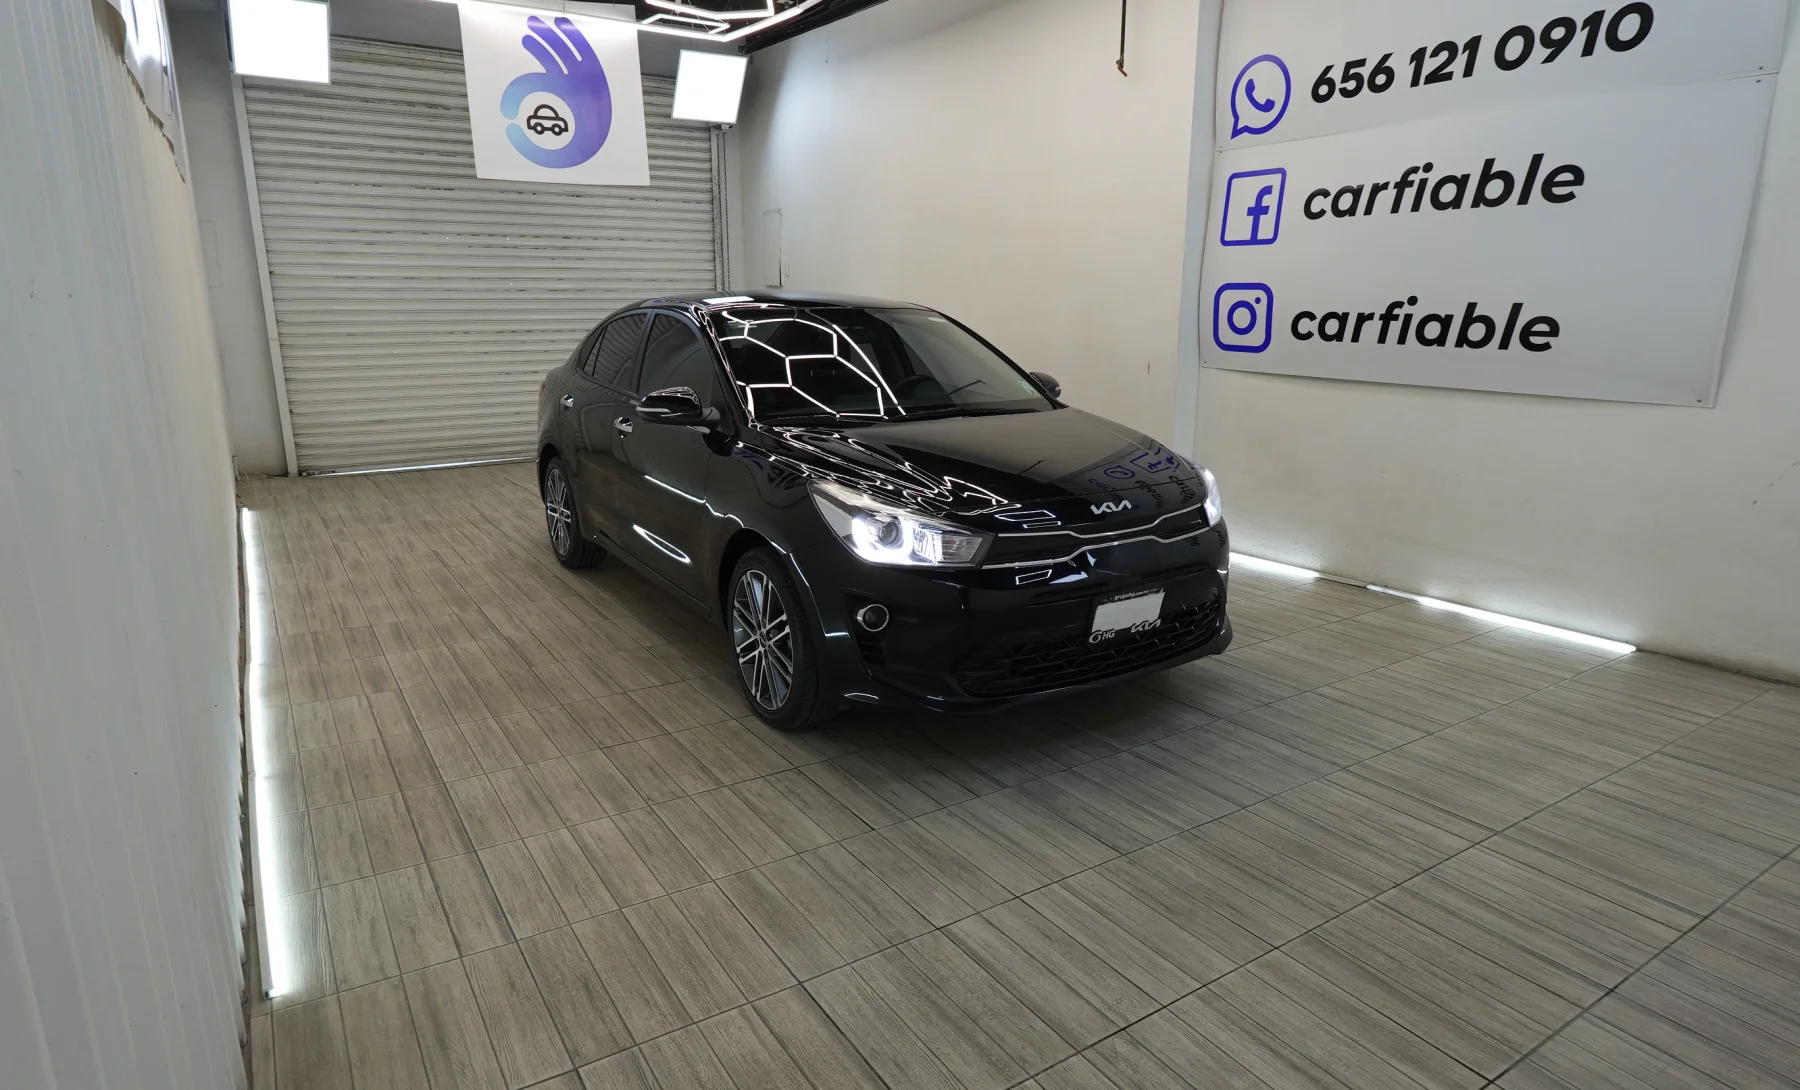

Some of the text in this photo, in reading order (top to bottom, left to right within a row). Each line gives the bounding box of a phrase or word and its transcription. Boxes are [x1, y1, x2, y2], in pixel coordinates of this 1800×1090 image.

[1310, 1, 1655, 104] 656 121 0910
[1302, 153, 1586, 221] carfiable
[1290, 295, 1561, 353] carfiable
[1090, 499, 1133, 515] KIA
